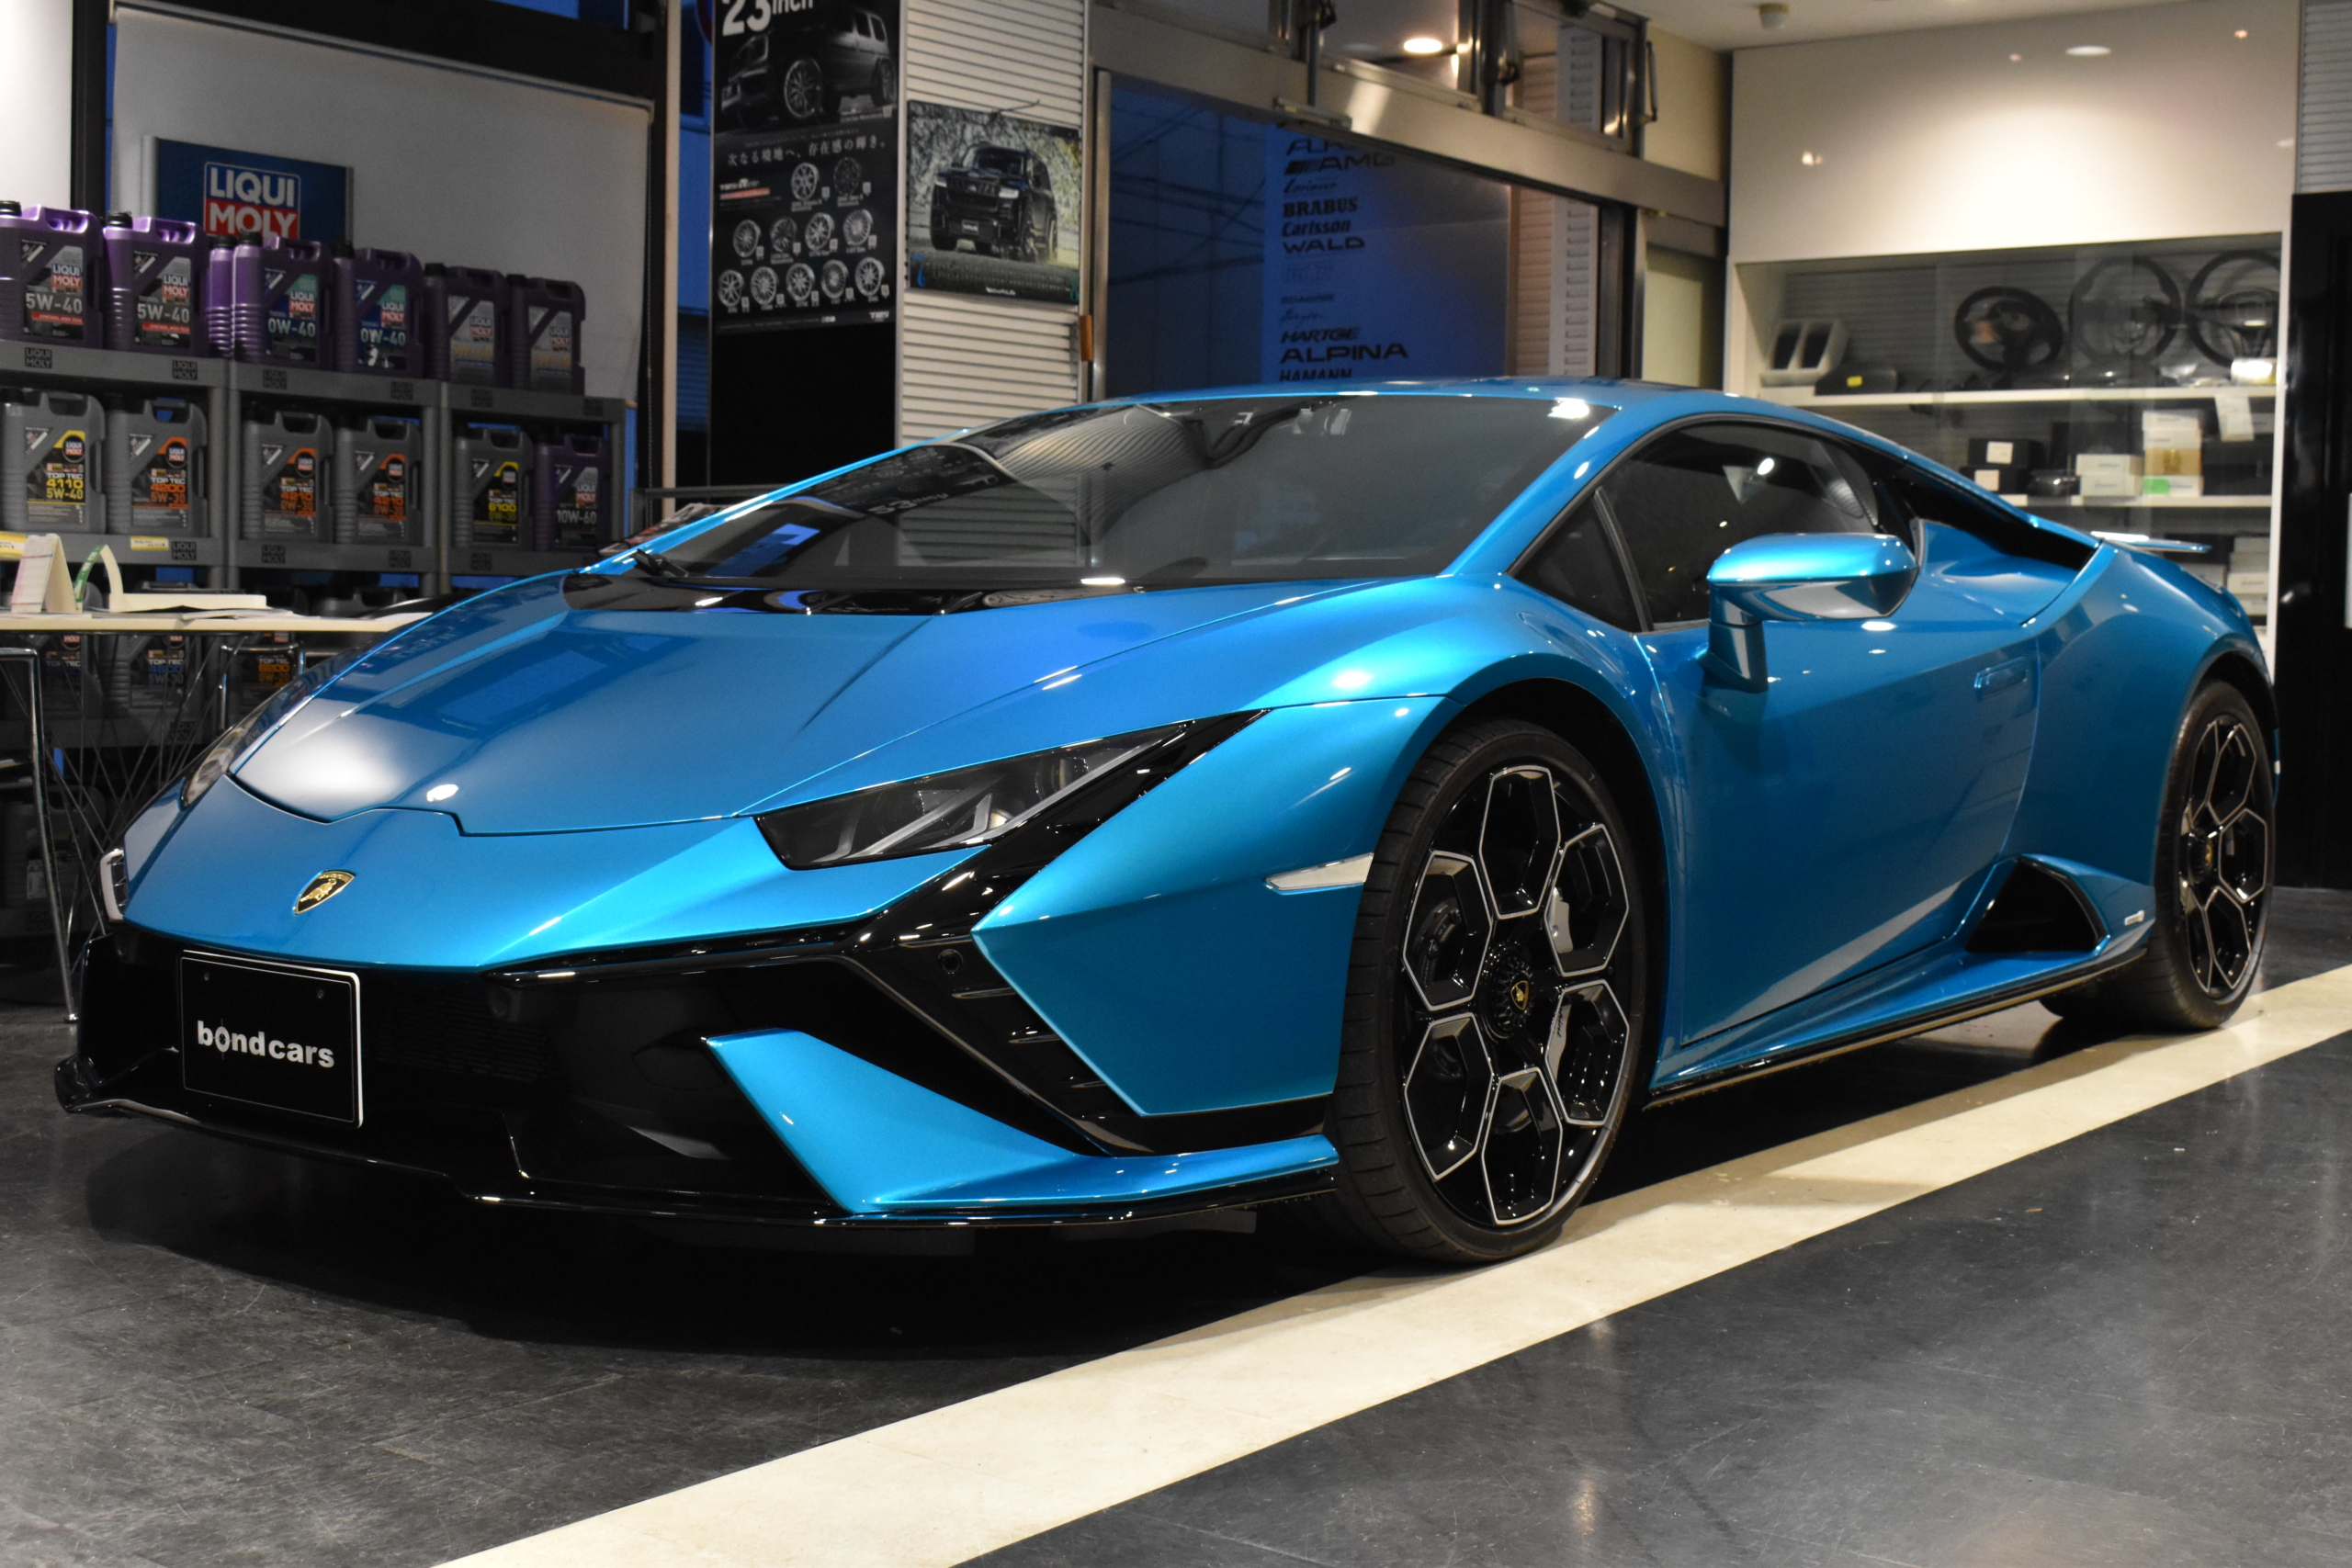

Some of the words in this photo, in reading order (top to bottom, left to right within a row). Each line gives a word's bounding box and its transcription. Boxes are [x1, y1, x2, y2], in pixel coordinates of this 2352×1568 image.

[209, 167, 296, 208] LIQUI
[1283, 197, 1358, 218] BRABUS
[209, 202, 298, 239] MOLY
[1282, 220, 1351, 237] Carlsson
[1283, 236, 1365, 254] WALD
[52, 265, 80, 276] LIQUI
[53, 276, 81, 287] MOLY
[164, 276, 188, 286] LIQUI
[164, 286, 189, 296] MOLY
[290, 291, 314, 301] LIQUI
[26, 293, 83, 314] 5W-40
[290, 301, 314, 312] MOLY
[381, 302, 404, 311] LIQUI
[137, 303, 190, 323] 5W-40
[381, 311, 404, 322] MOLY
[268, 318, 316, 337] 0W-40
[361, 328, 405, 345] 0W-40
[1281, 327, 1360, 344] HARTGE
[27, 348, 51, 357] LIQUI
[1281, 343, 1408, 364] ALPINA
[27, 358, 51, 367] MOLY
[1279, 367, 1352, 381] HAMANN
[46, 479, 84, 489] 4110
[47, 488, 84, 500] 5W-40
[151, 492, 186, 503] 5W-30
[557, 510, 596, 525] 10W-60
